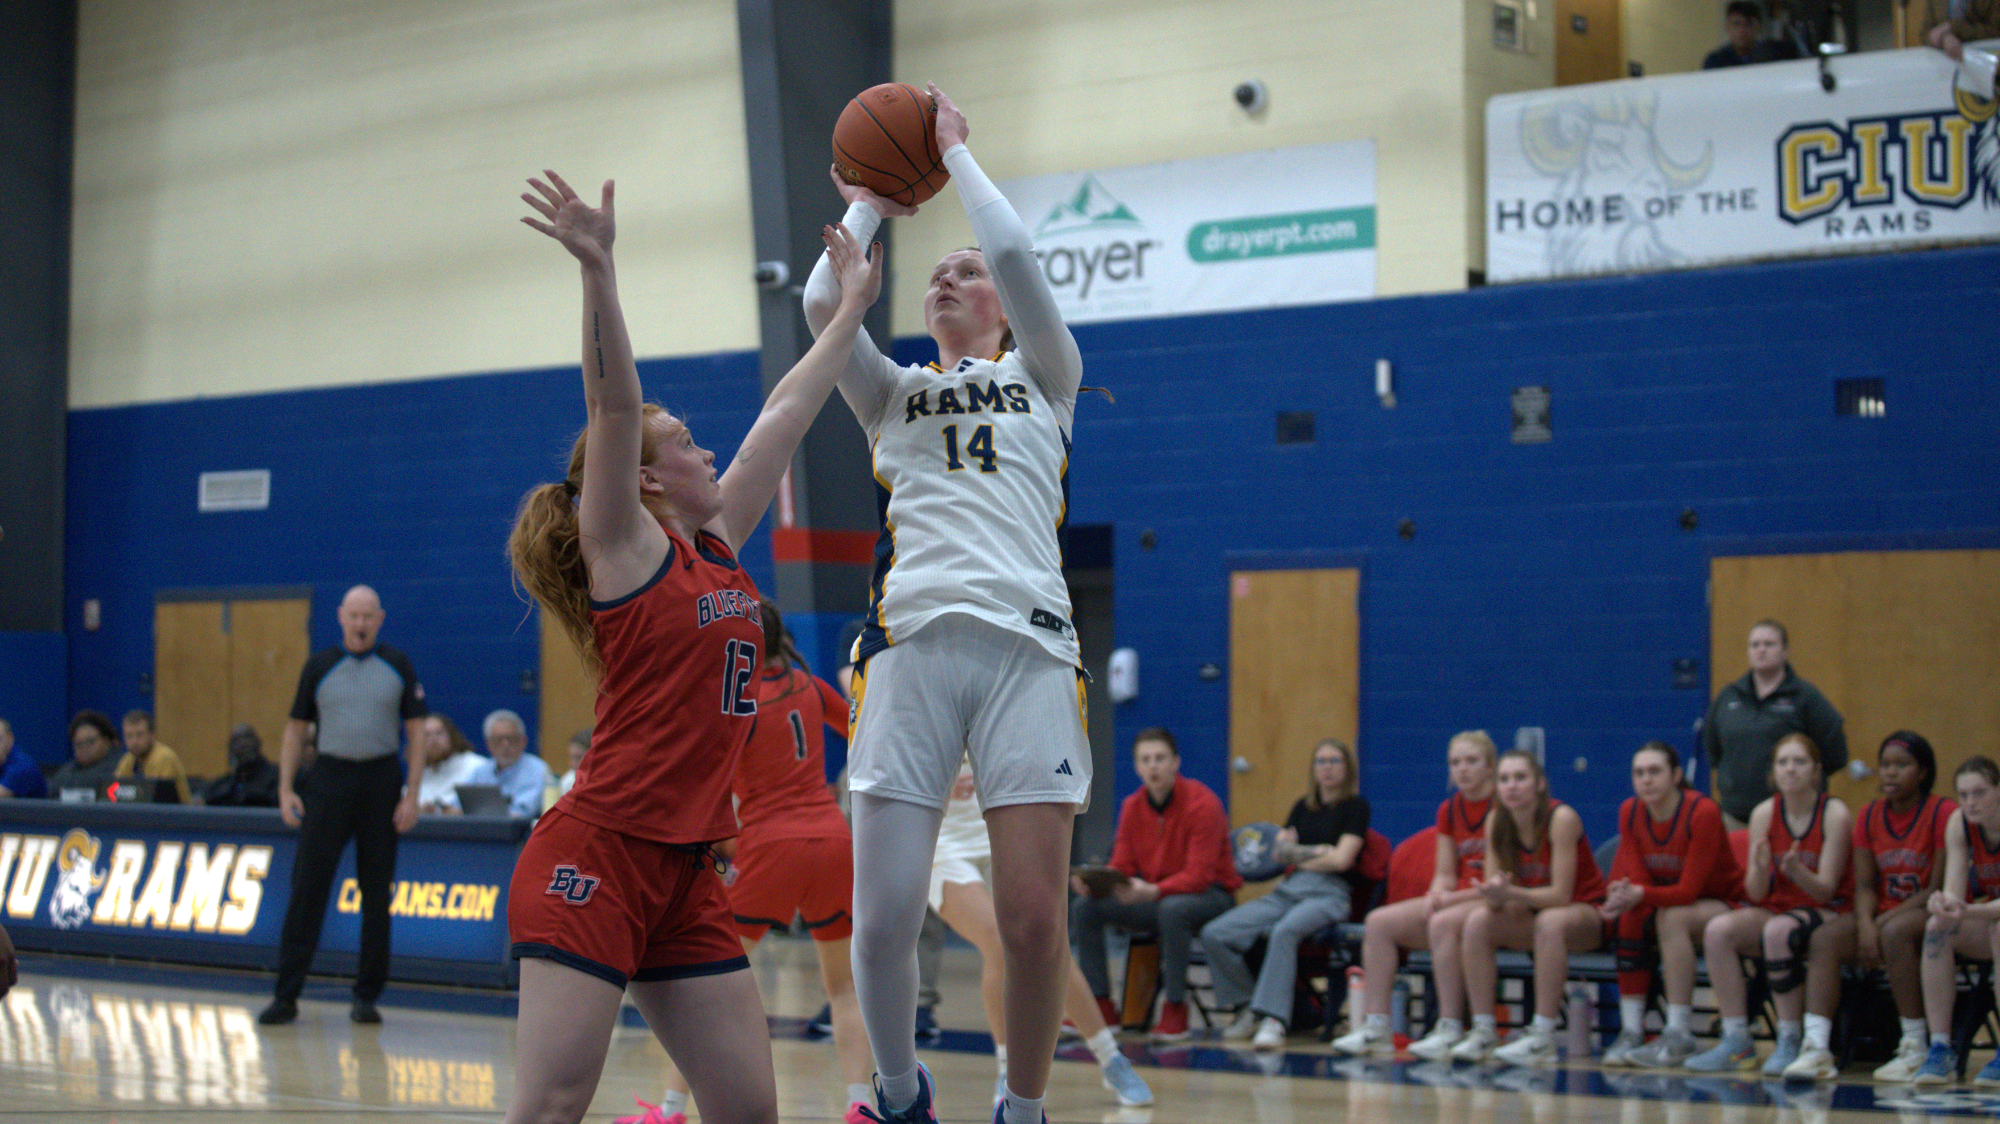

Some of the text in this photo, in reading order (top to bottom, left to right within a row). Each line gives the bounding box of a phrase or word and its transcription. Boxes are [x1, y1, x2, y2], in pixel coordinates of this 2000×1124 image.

[1776, 108, 1976, 225] CIU
[1495, 187, 1758, 233] HOME OF THE
[1824, 210, 1932, 237] RAMS
[1201, 220, 1358, 257] drayerpt.com
[1035, 239, 1154, 300] ayer
[905, 379, 1031, 424] RAMS
[942, 423, 999, 473] 14
[697, 589, 764, 633] BLUEFIE
[721, 638, 757, 716] 12
[787, 709, 808, 761] 1
[91, 839, 273, 935] RAMS
[337, 877, 499, 921] CIAMS.COM
[545, 864, 601, 906] BU
